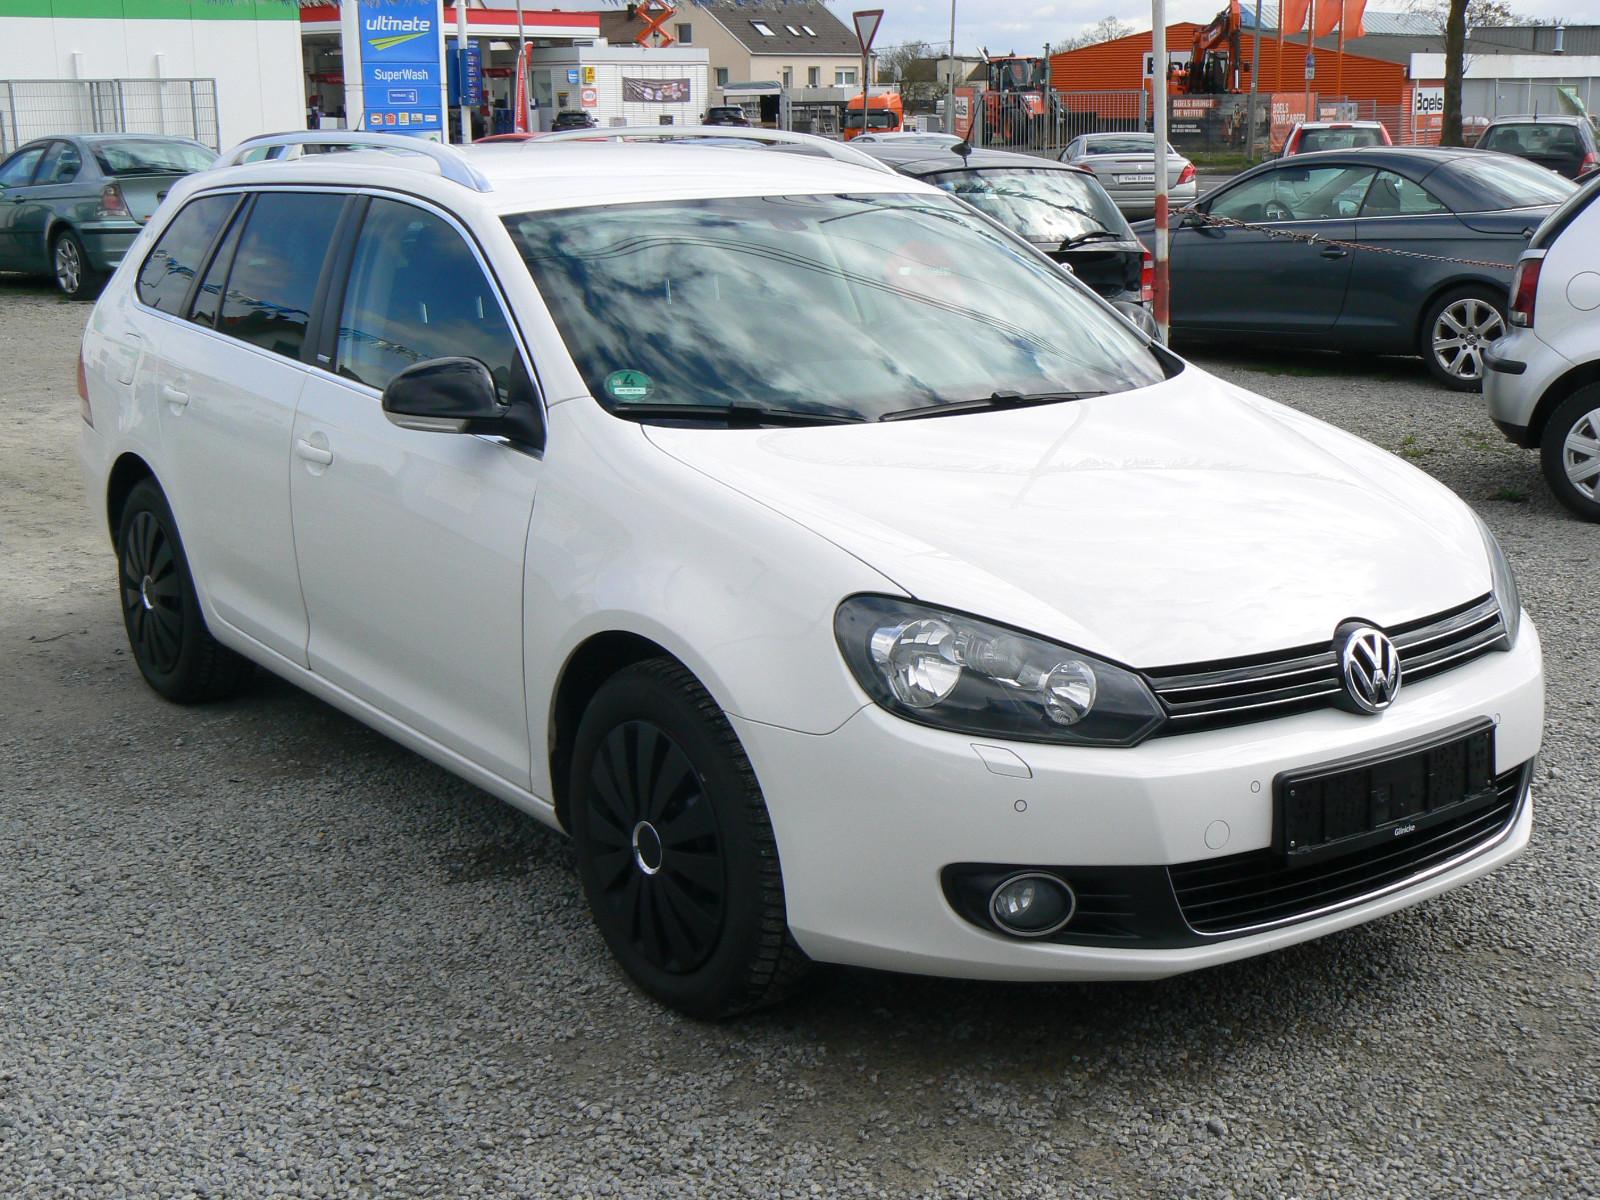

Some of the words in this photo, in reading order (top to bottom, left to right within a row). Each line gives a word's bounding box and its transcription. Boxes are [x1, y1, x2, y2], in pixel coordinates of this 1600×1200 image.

[366, 15, 430, 31] ultimate
[374, 68, 428, 82] SuperWash
[623, 374, 636, 386] 4
